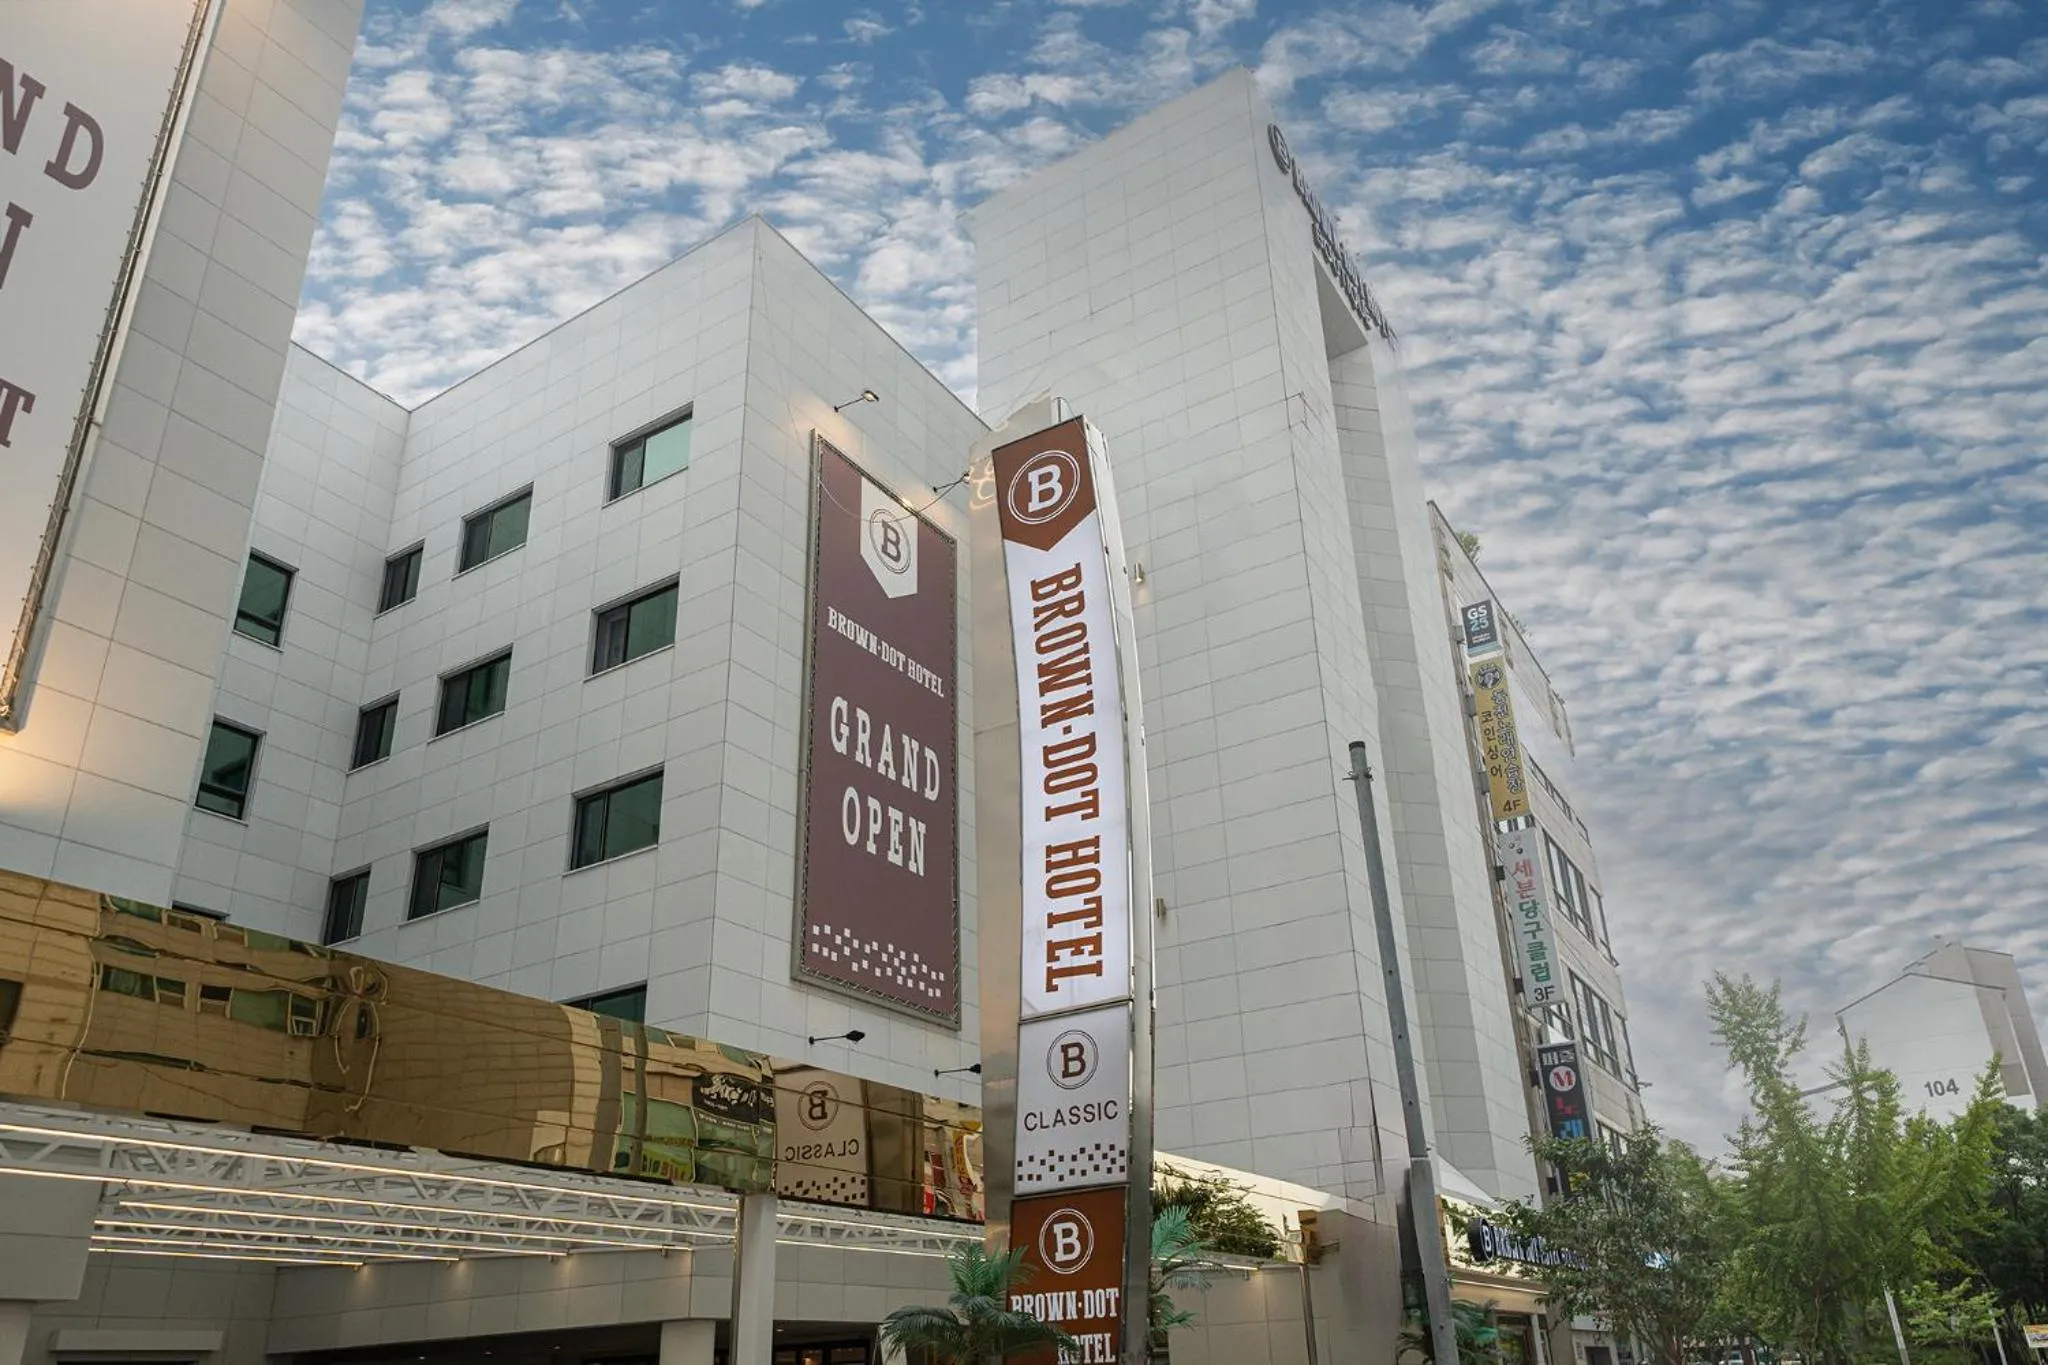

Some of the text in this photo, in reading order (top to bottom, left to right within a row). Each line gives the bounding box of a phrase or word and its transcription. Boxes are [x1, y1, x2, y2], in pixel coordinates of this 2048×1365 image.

[1028, 463, 1063, 513] B
[881, 519, 901, 562] B
[1467, 604, 1488, 620] GS
[1470, 617, 1489, 632] 25
[907, 658, 944, 698] HOTEL
[830, 696, 941, 802] GRAND
[1503, 799, 1521, 813] 4F
[842, 786, 927, 877] OPEN
[1045, 835, 1103, 993] HOTEL
[1534, 984, 1556, 1001] 3F
[1060, 1041, 1087, 1079] B
[1923, 1078, 1960, 1098] 104
[1023, 1100, 1118, 1132] CLASSIC
[1053, 1221, 1081, 1262] B
